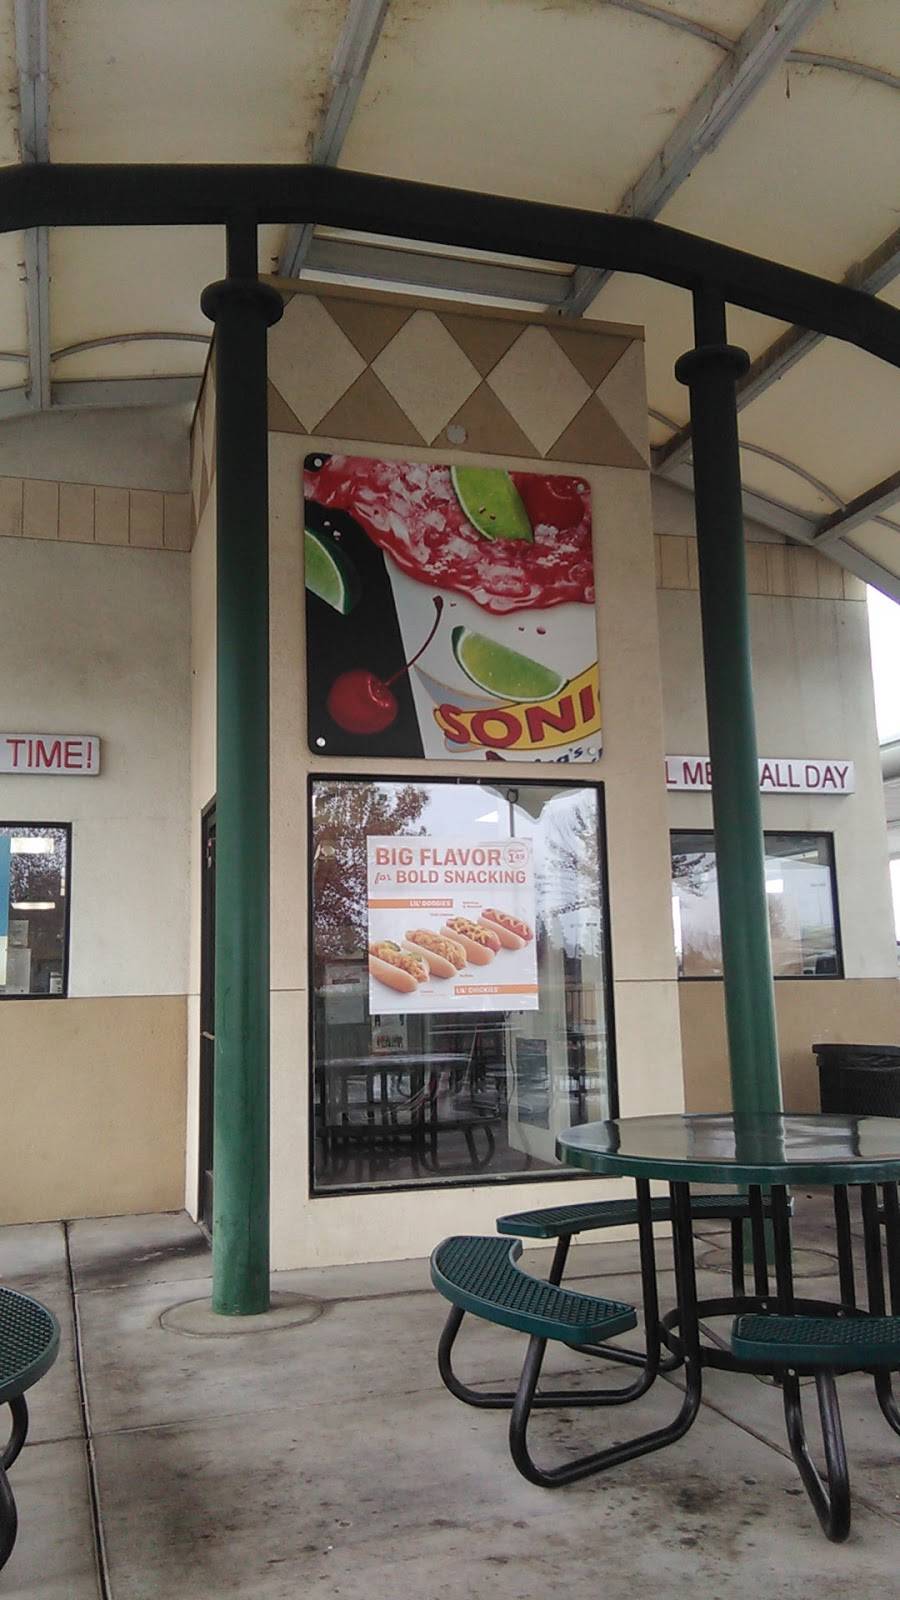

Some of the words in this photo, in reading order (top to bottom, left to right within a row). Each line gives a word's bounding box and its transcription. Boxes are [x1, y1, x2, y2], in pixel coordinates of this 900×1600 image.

[438, 684, 601, 749] SONI
[6, 738, 92, 769] TIME!
[759, 762, 801, 789] ALL
[805, 764, 849, 789] DAY
[375, 847, 413, 866] BIG
[420, 847, 501, 866] FLAVOR
[374, 871, 391, 885] for
[396, 870, 439, 884] BOLD
[444, 870, 526, 884] SNACKING
